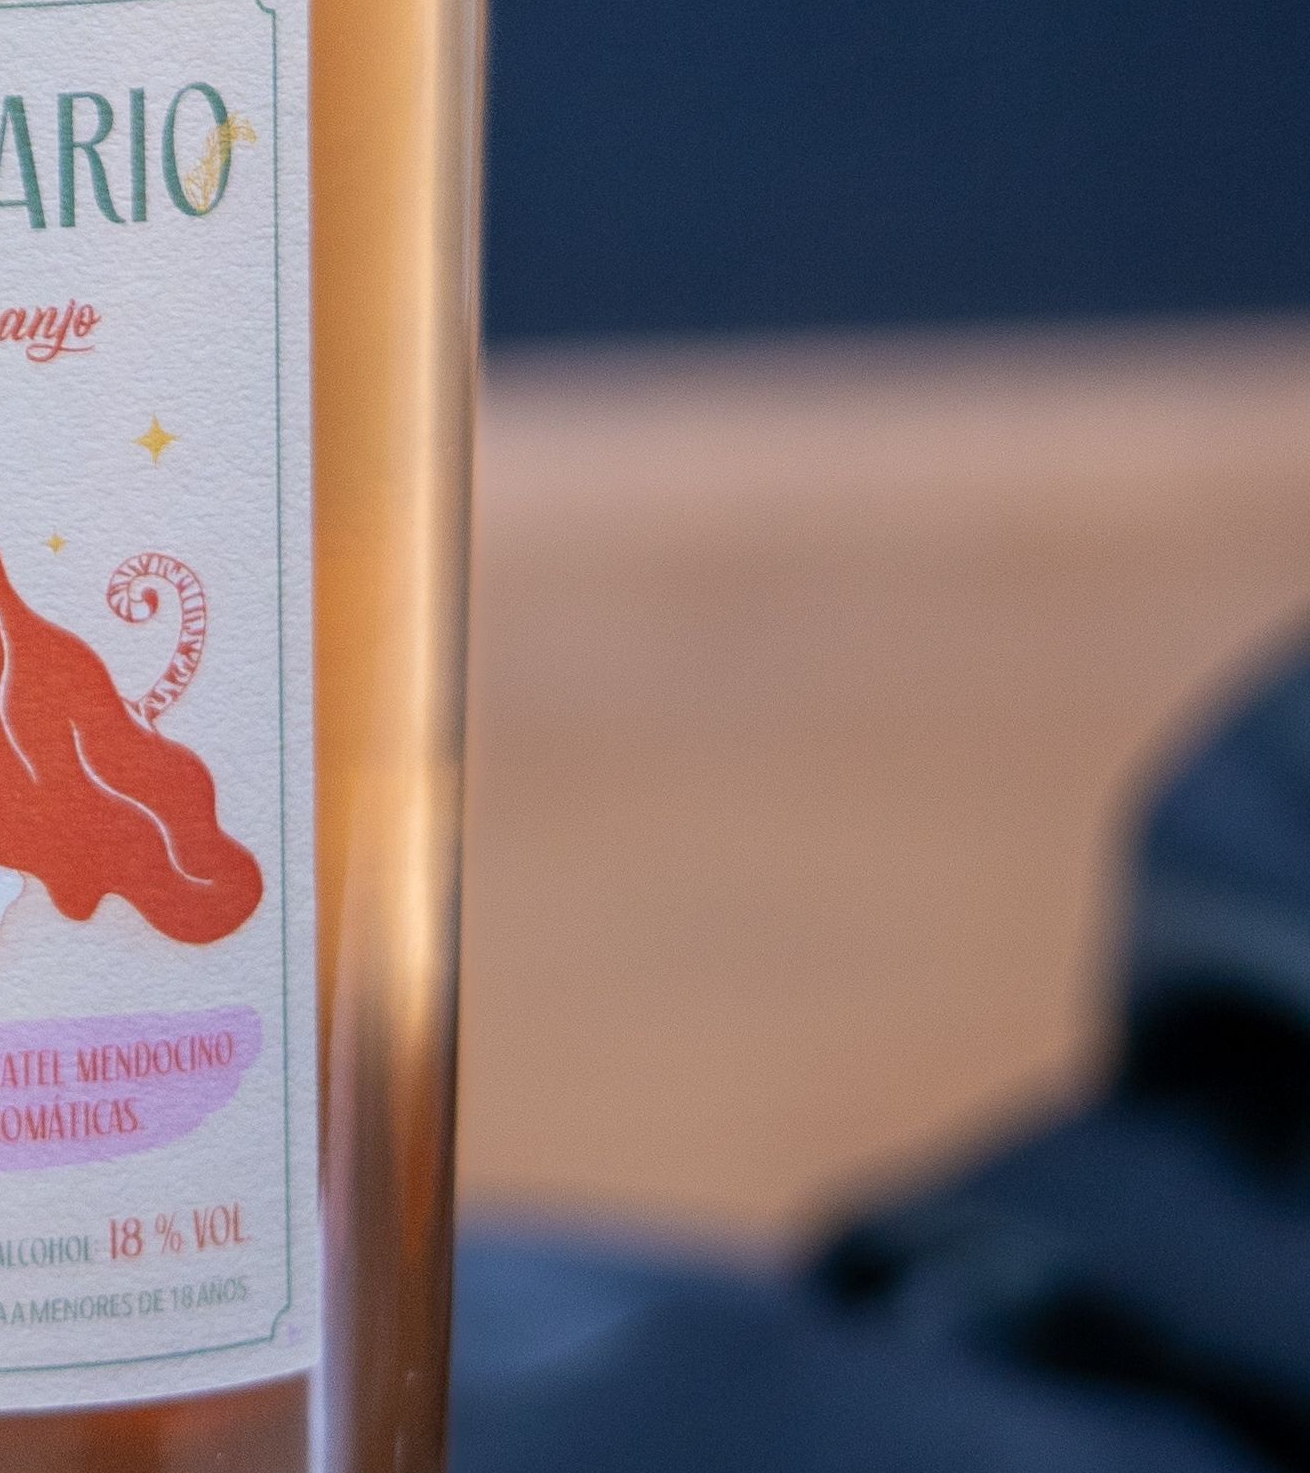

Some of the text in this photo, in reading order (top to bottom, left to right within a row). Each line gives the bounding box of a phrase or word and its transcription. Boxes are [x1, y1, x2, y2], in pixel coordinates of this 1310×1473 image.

[77, 1030, 236, 1084] MENDOCINO
[109, 1216, 144, 1260] 18
[154, 1212, 182, 1254] %
[10, 1300, 26, 1325] A
[30, 1291, 132, 1324] MENORES
[137, 1288, 164, 1315] DE
[173, 1284, 194, 1312] 18
